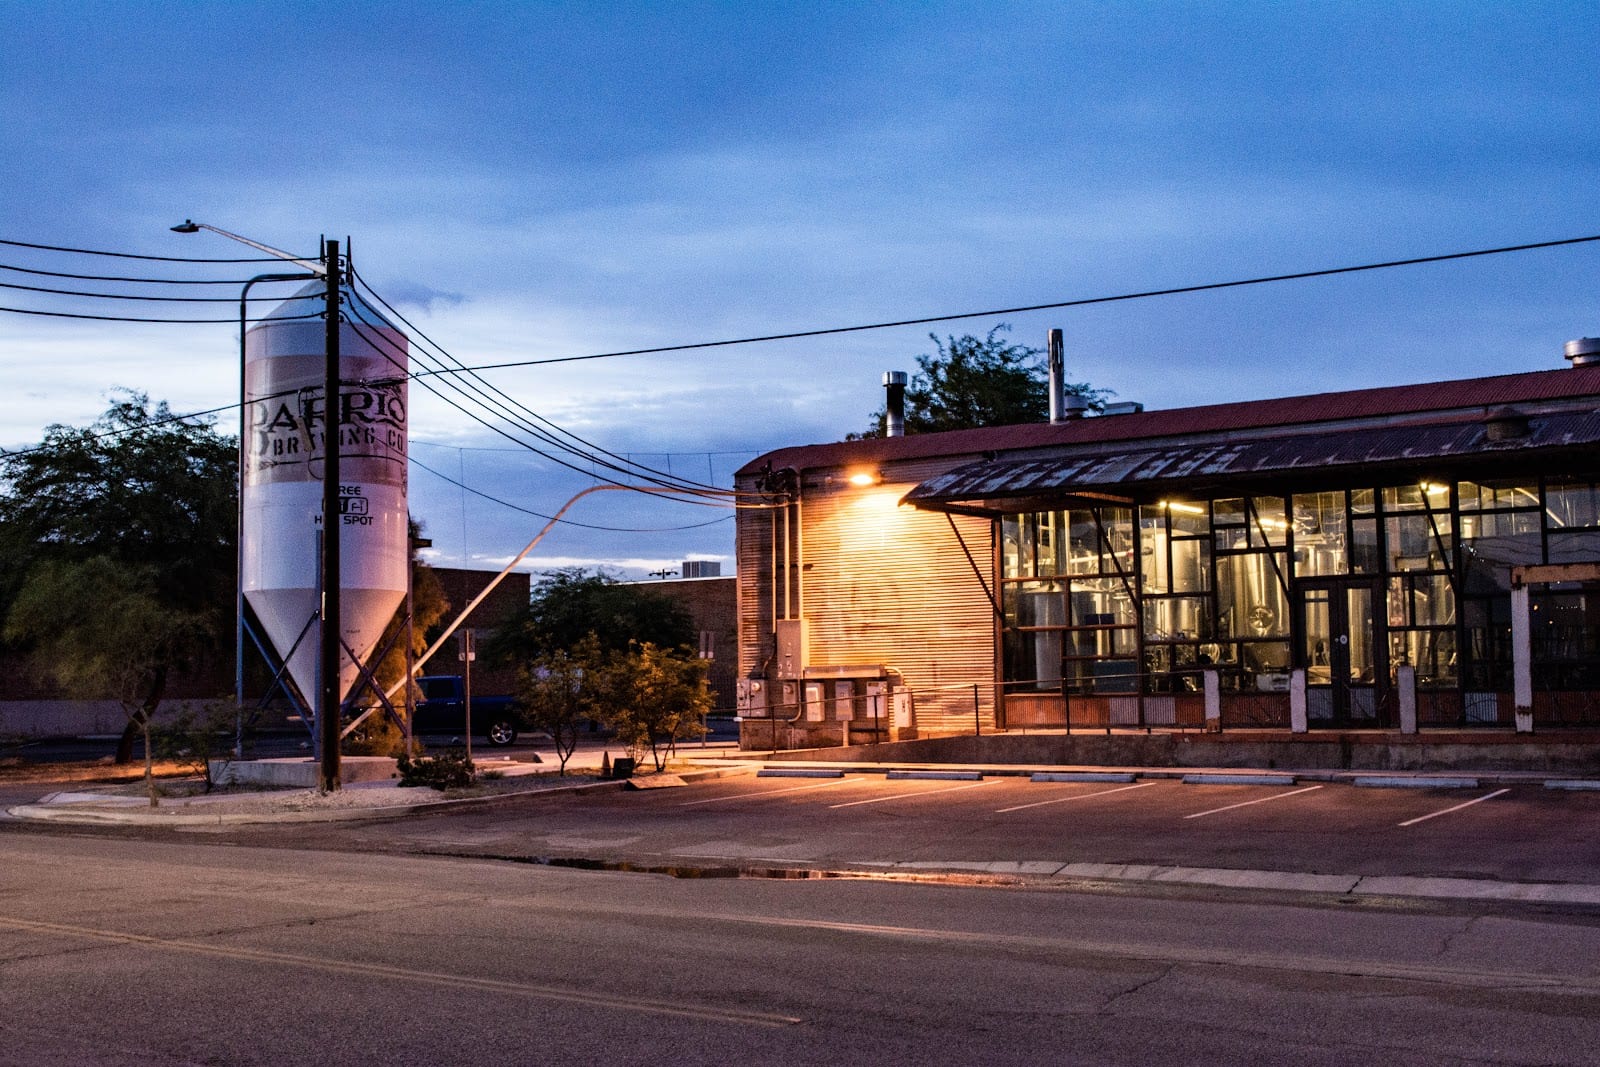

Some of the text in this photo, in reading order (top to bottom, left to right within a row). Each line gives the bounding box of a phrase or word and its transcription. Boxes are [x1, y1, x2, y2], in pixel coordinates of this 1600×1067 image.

[273, 427, 375, 456] BRING
[333, 485, 361, 496] REE
[343, 515, 374, 526] SPOT
